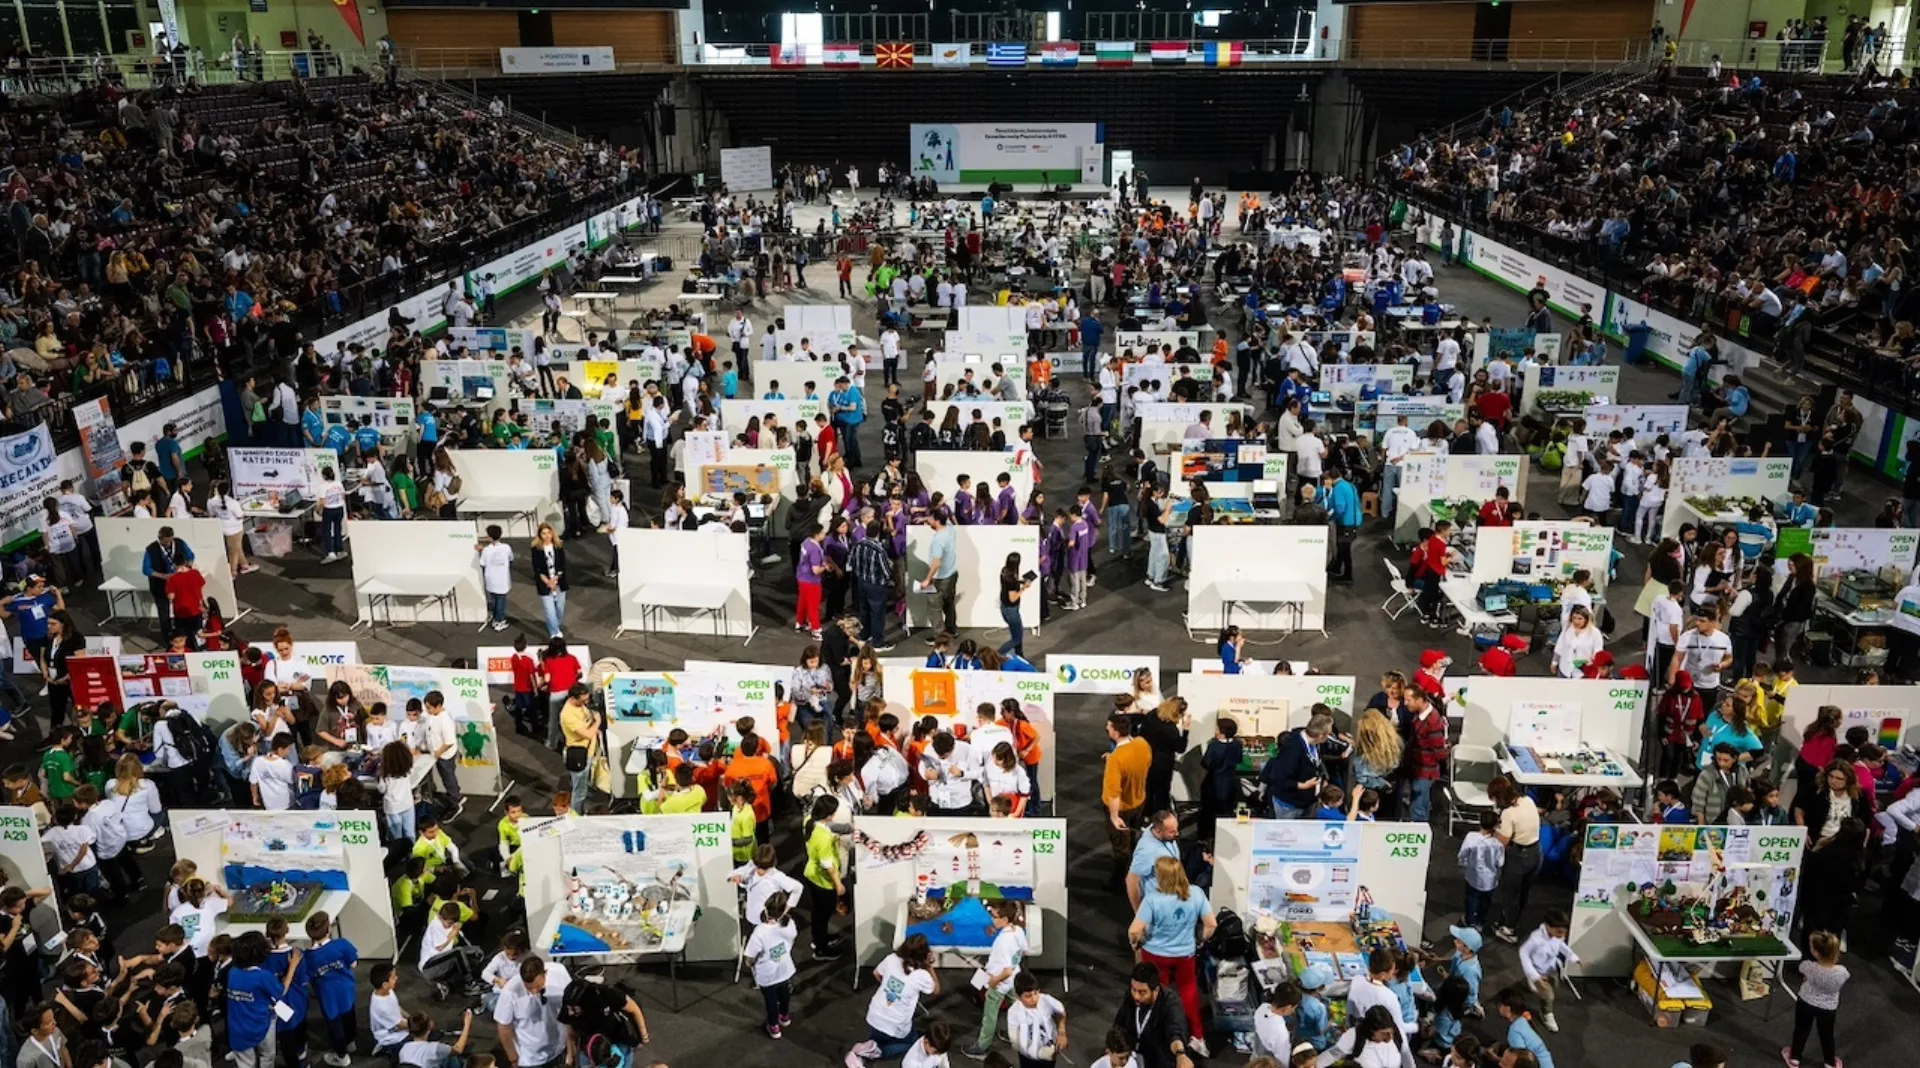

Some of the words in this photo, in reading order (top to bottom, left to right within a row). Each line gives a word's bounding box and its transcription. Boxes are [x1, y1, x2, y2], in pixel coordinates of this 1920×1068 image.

[883, 429, 896, 445] 22
[242, 456, 294, 464] ΚΑΤΕΡΙΝΗΣ
[1890, 535, 1916, 544] OPEN
[202, 660, 234, 668] OPEN
[452, 677, 482, 686] OPEN
[738, 680, 770, 690] OPEN
[1016, 680, 1050, 690] OPEN
[460, 689, 478, 698] A12
[1316, 685, 1350, 694] OPEN
[1609, 688, 1644, 698] OPEN
[746, 692, 764, 700] A13
[1024, 694, 1042, 702] A14
[1323, 696, 1342, 706] A15
[1614, 700, 1635, 710] A16
[4, 830, 28, 840] A29
[341, 834, 368, 844] A30
[1024, 829, 1061, 840] PEN
[1386, 833, 1426, 844] OPEN
[696, 836, 720, 846] A31
[1758, 836, 1800, 848] OPEN
[1390, 847, 1419, 857] A33
[1762, 852, 1791, 862] A34
